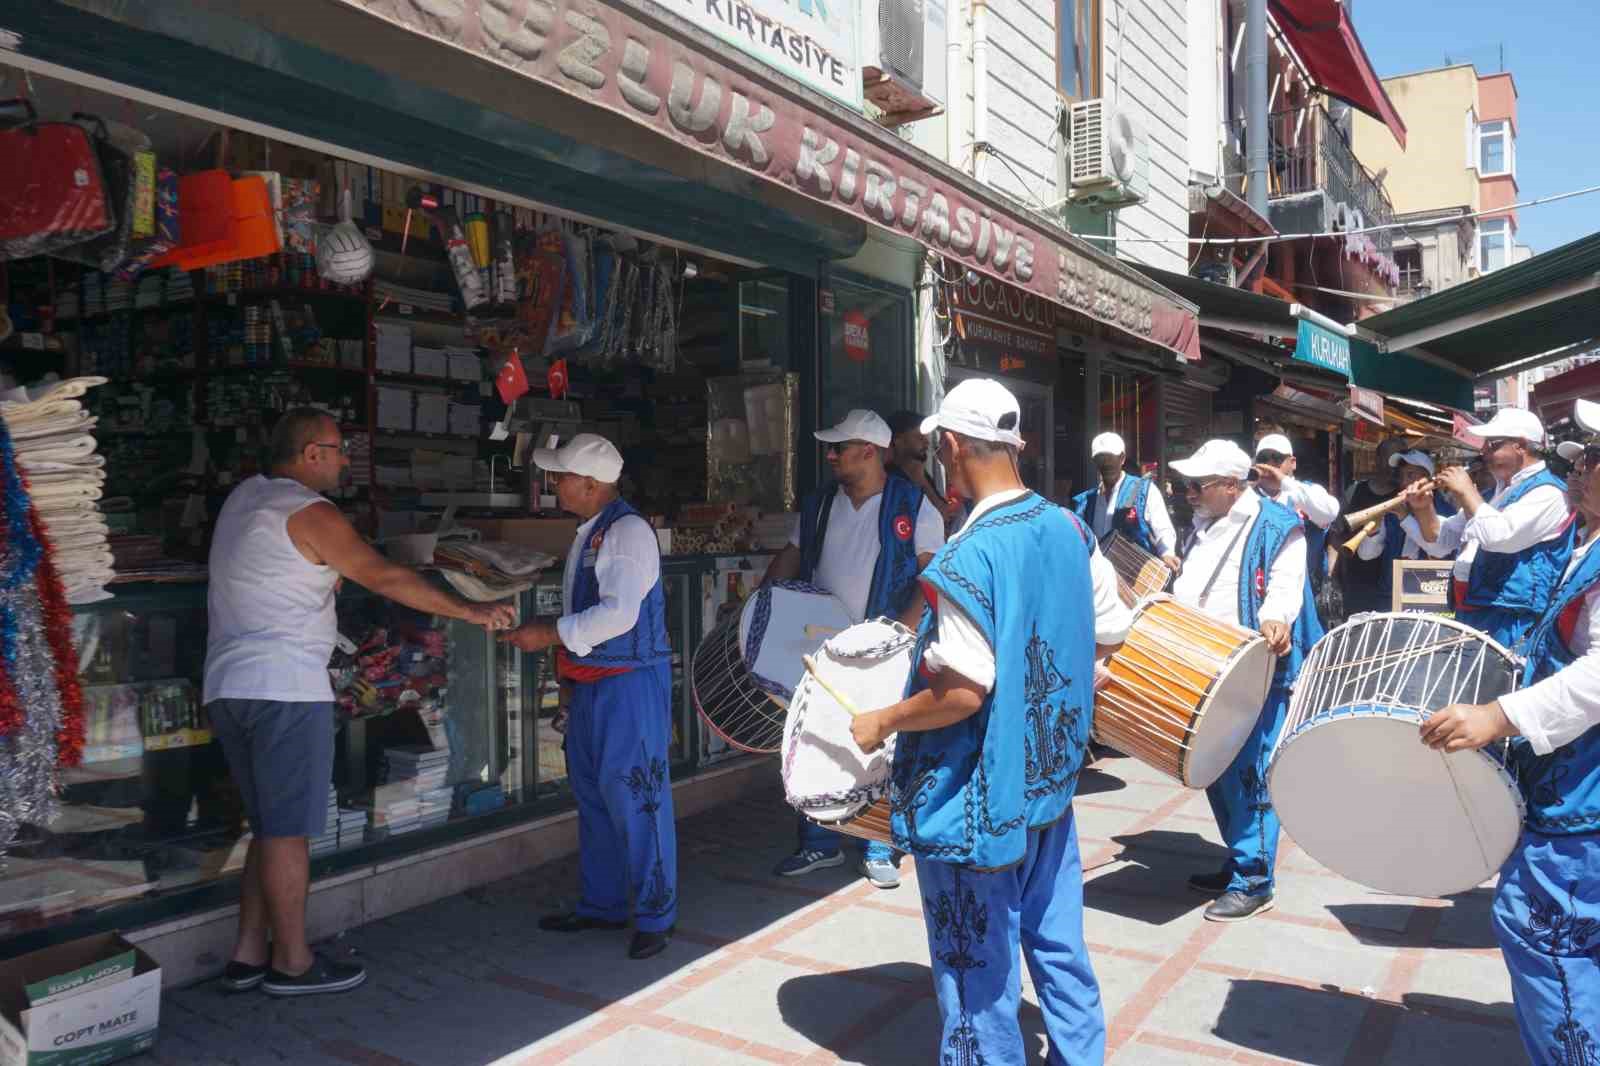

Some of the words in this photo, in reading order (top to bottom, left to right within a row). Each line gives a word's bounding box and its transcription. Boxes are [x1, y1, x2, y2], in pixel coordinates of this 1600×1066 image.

[796, 127, 1035, 281] KIRTASİYE
[54, 1023, 96, 1046] COPY
[98, 1010, 137, 1032] MATE
